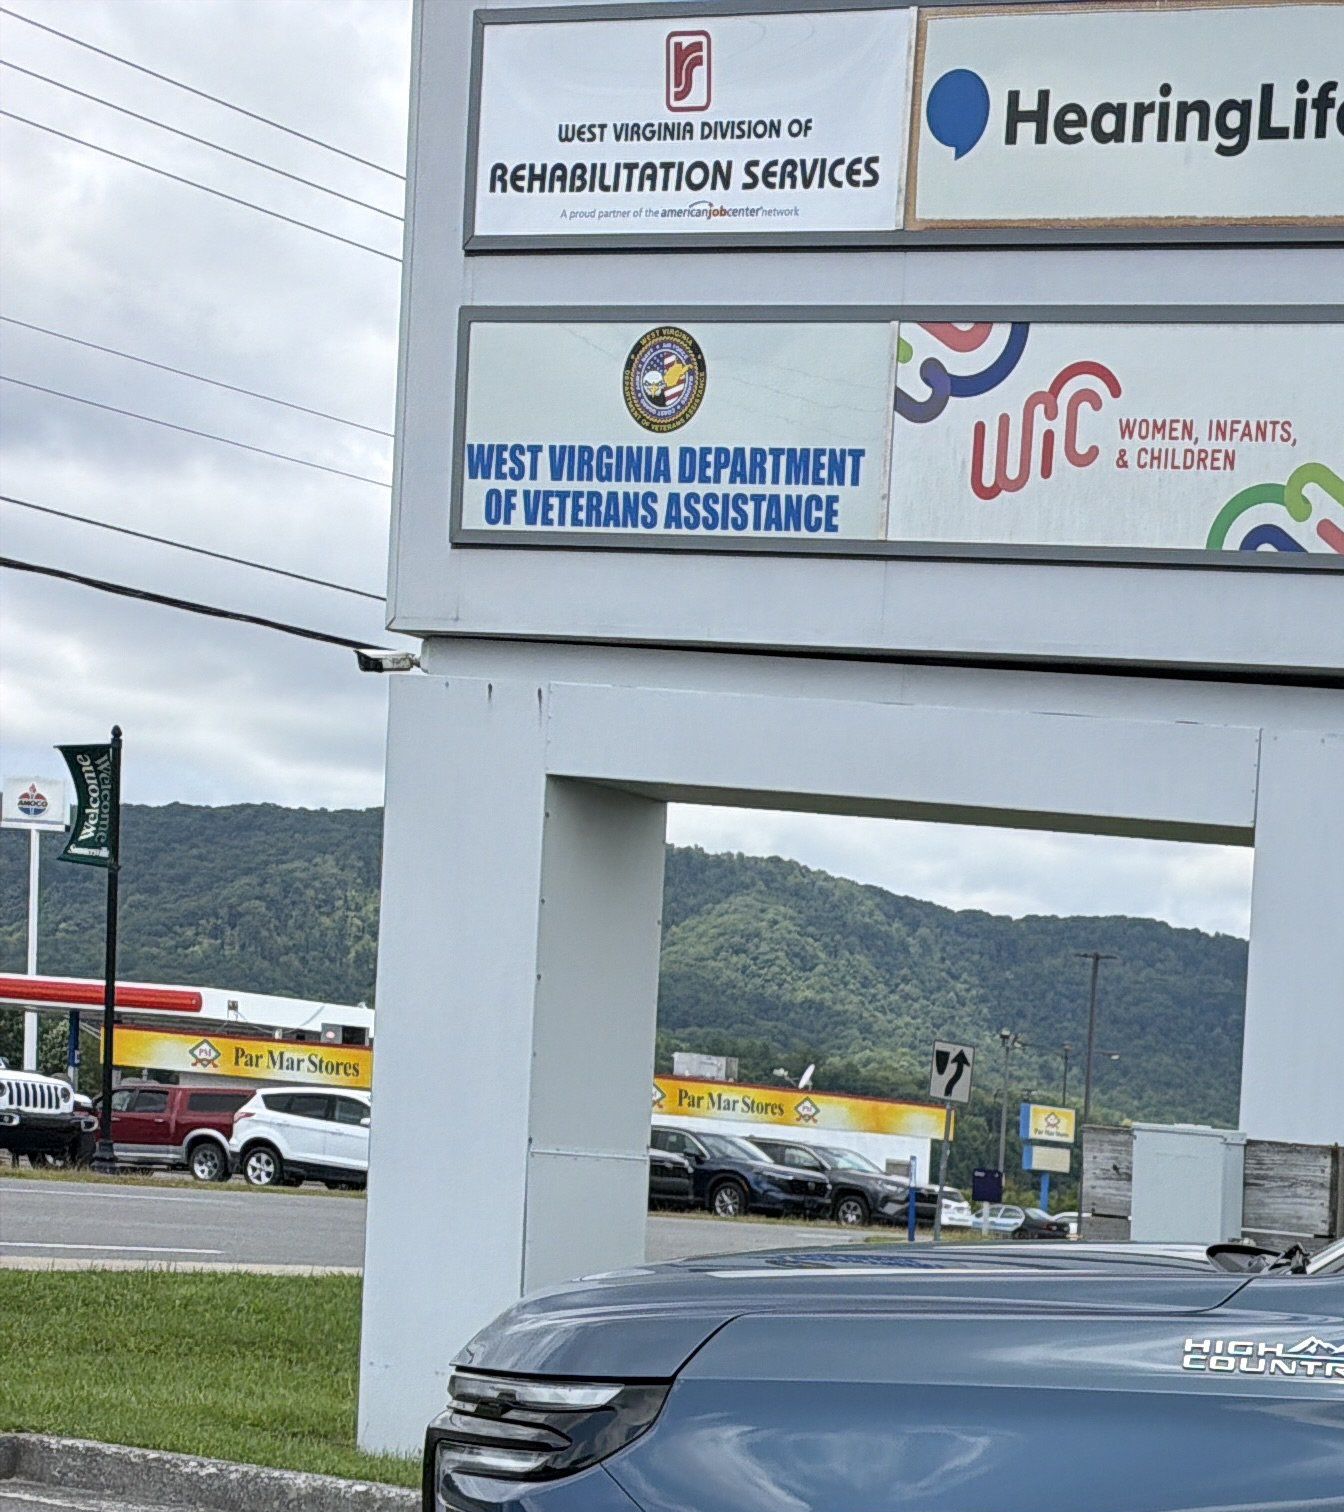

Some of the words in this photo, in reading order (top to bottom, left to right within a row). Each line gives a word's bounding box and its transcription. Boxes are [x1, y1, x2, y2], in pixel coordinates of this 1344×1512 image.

[558, 123, 607, 143] WEST
[613, 121, 694, 142] VIRGINIA
[700, 119, 781, 140] DIVISION
[787, 118, 813, 138] OF
[489, 159, 733, 194] REHABILITATION
[741, 155, 881, 190] SERVICES
[560, 209, 567, 219] A
[569, 209, 596, 221] proud
[597, 209, 631, 221] partner
[632, 207, 644, 218] of
[645, 208, 660, 218] the
[1118, 418, 1198, 445] WOMEN,
[1208, 418, 1297, 447] INFANTS,
[467, 443, 543, 481] WEST
[549, 444, 672, 484] VIRGINIA
[678, 446, 866, 487] DEPARTMENT
[1116, 448, 1129, 469] &
[1137, 448, 1236, 471] CHILDREN
[484, 488, 517, 526] OF
[523, 489, 658, 530] VETERANS
[663, 492, 839, 533] ASSISTANCE
[76, 754, 101, 841] Welcome
[234, 1046, 264, 1068] Par
[267, 1049, 305, 1071] Mar
[307, 1053, 360, 1077] Stores
[677, 1088, 705, 1108] Par
[706, 1092, 739, 1112] Mar
[741, 1095, 785, 1116] Stores
[1184, 1338, 1284, 1357] HIGH
